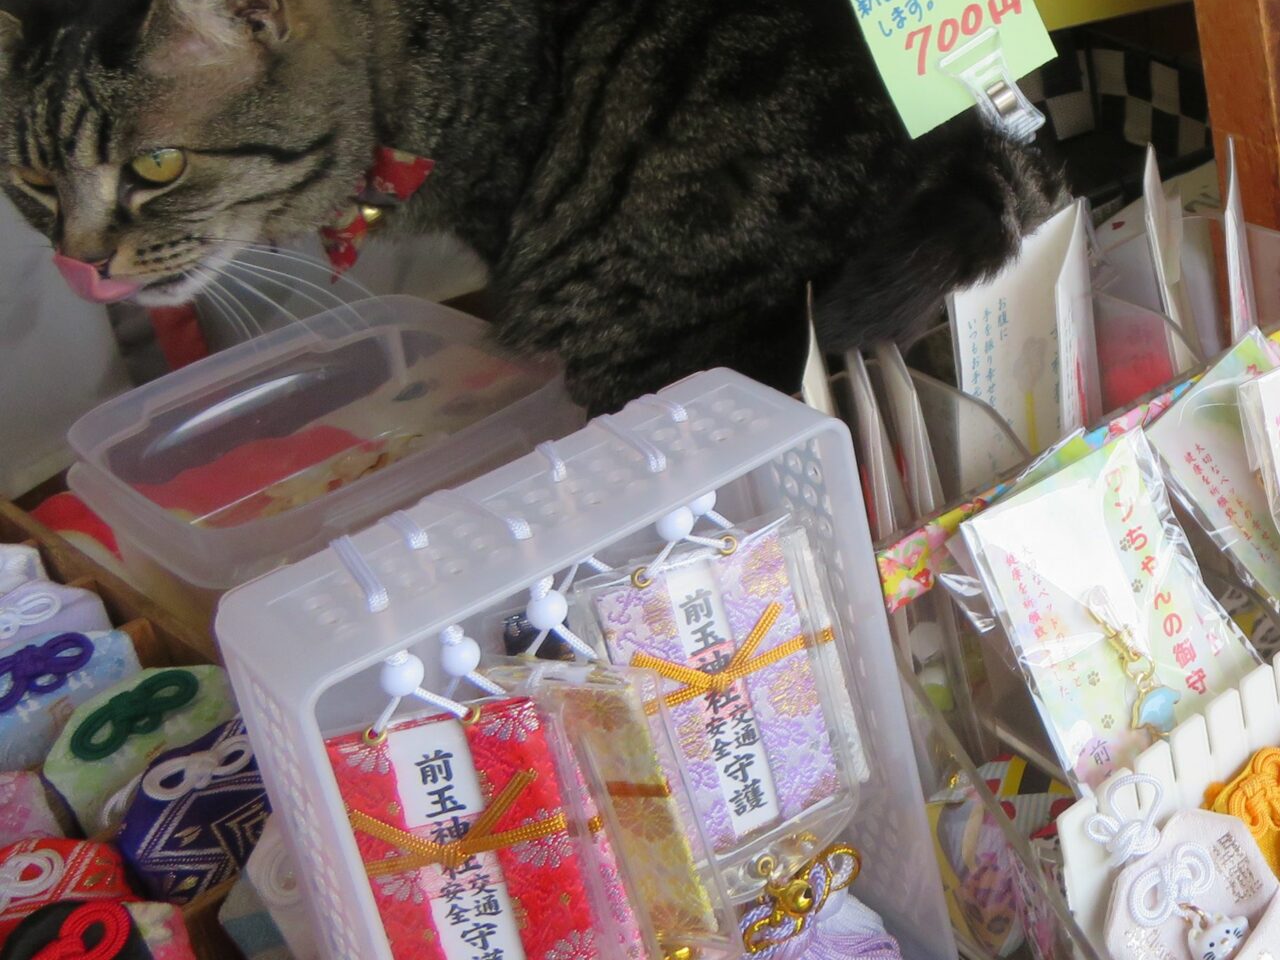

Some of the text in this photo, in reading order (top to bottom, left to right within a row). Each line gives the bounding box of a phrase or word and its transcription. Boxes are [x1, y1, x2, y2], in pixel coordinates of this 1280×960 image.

[705, 717, 741, 763] 安全
[728, 704, 763, 751] 交通
[723, 752, 769, 818] 守護
[438, 881, 473, 926] 安全
[470, 873, 504, 918] 交通
